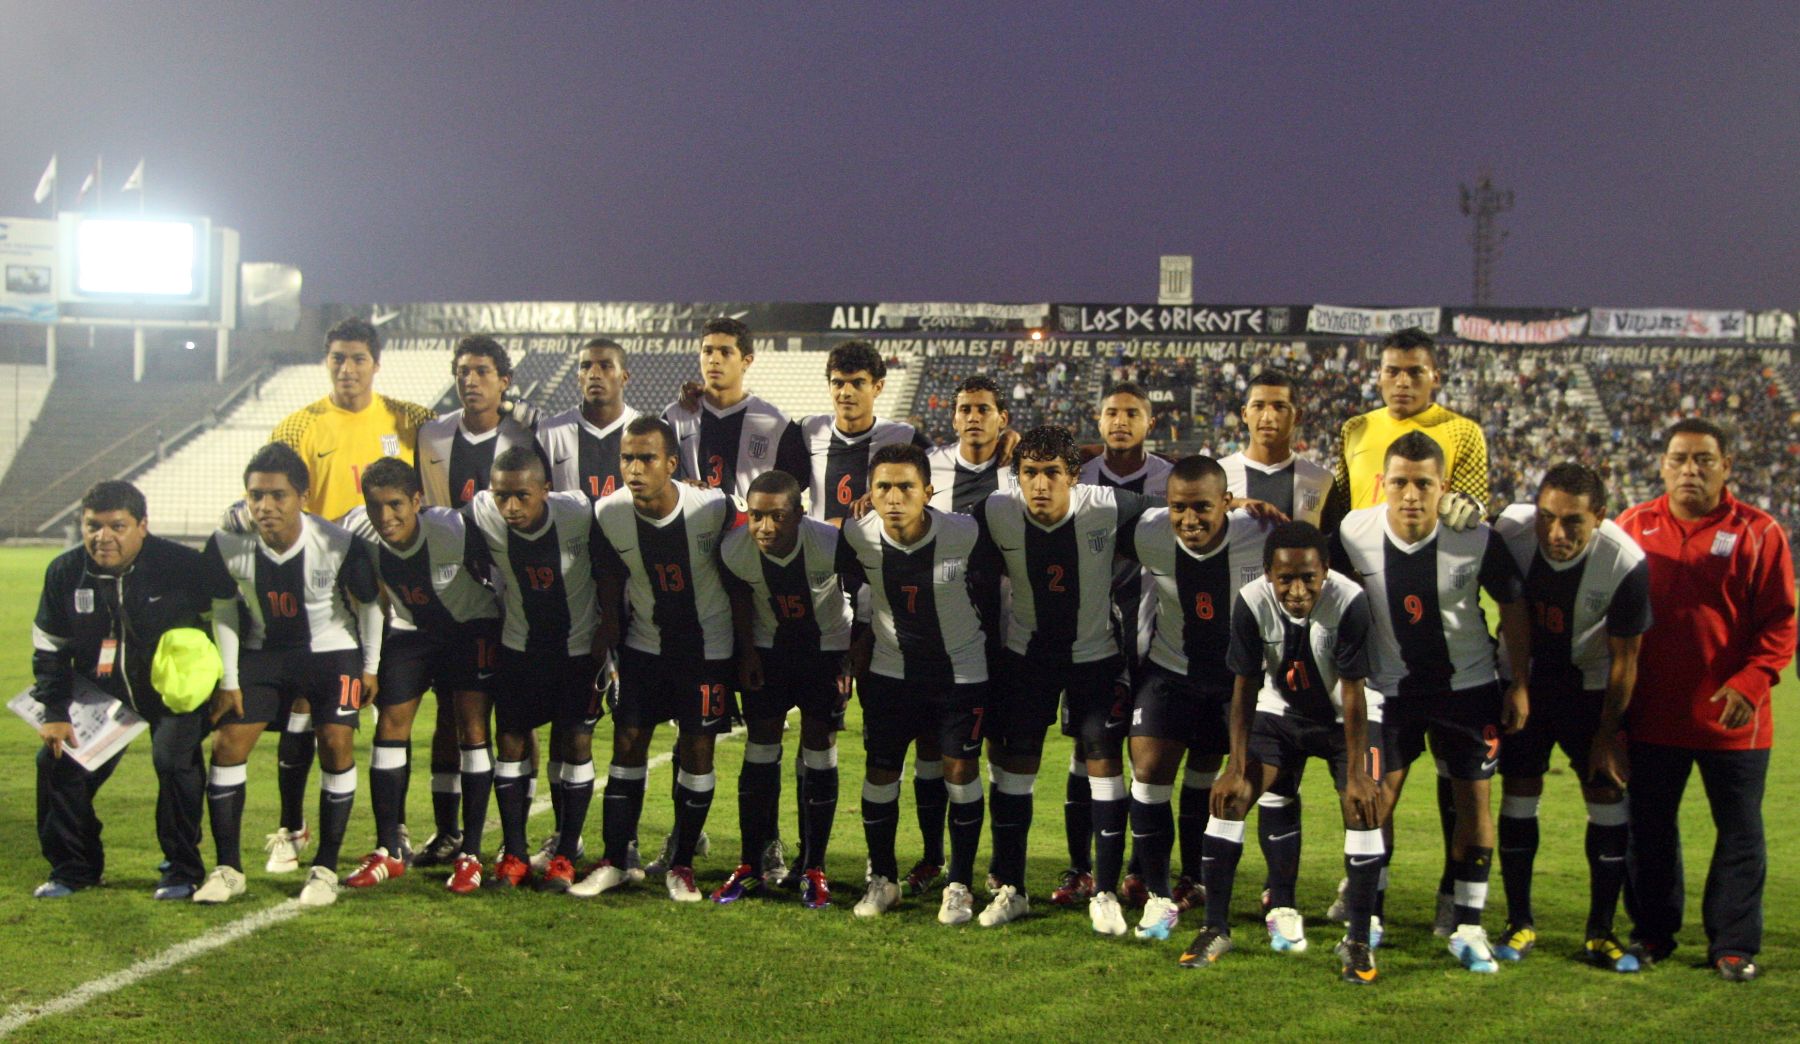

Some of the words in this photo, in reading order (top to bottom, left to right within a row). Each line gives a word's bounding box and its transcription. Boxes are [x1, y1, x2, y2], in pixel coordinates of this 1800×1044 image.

[831, 306, 882, 328] ALIA
[1081, 306, 1122, 332] LOS
[1126, 306, 1154, 331] DE
[1159, 307, 1262, 333] ORIENTE
[528, 333, 568, 353] PERÚ
[645, 339, 664, 354] ES
[665, 339, 700, 355] ALIA
[967, 340, 988, 356] ES
[1059, 340, 1071, 357] Y
[1072, 340, 1091, 357] EL
[1141, 340, 1162, 358] ES
[707, 455, 723, 487] 3
[462, 478, 475, 500] 4
[588, 475, 616, 497] 14
[836, 474, 852, 505] 6
[525, 566, 554, 589] 19
[654, 563, 685, 592] 13
[1047, 565, 1066, 592] 2
[267, 591, 298, 618] 10
[776, 595, 806, 618] 15
[900, 586, 919, 614] 7
[1195, 592, 1215, 620] 8
[1404, 594, 1424, 625] 9
[340, 675, 362, 709] 10
[700, 683, 728, 716] 13
[971, 707, 985, 740] 7
